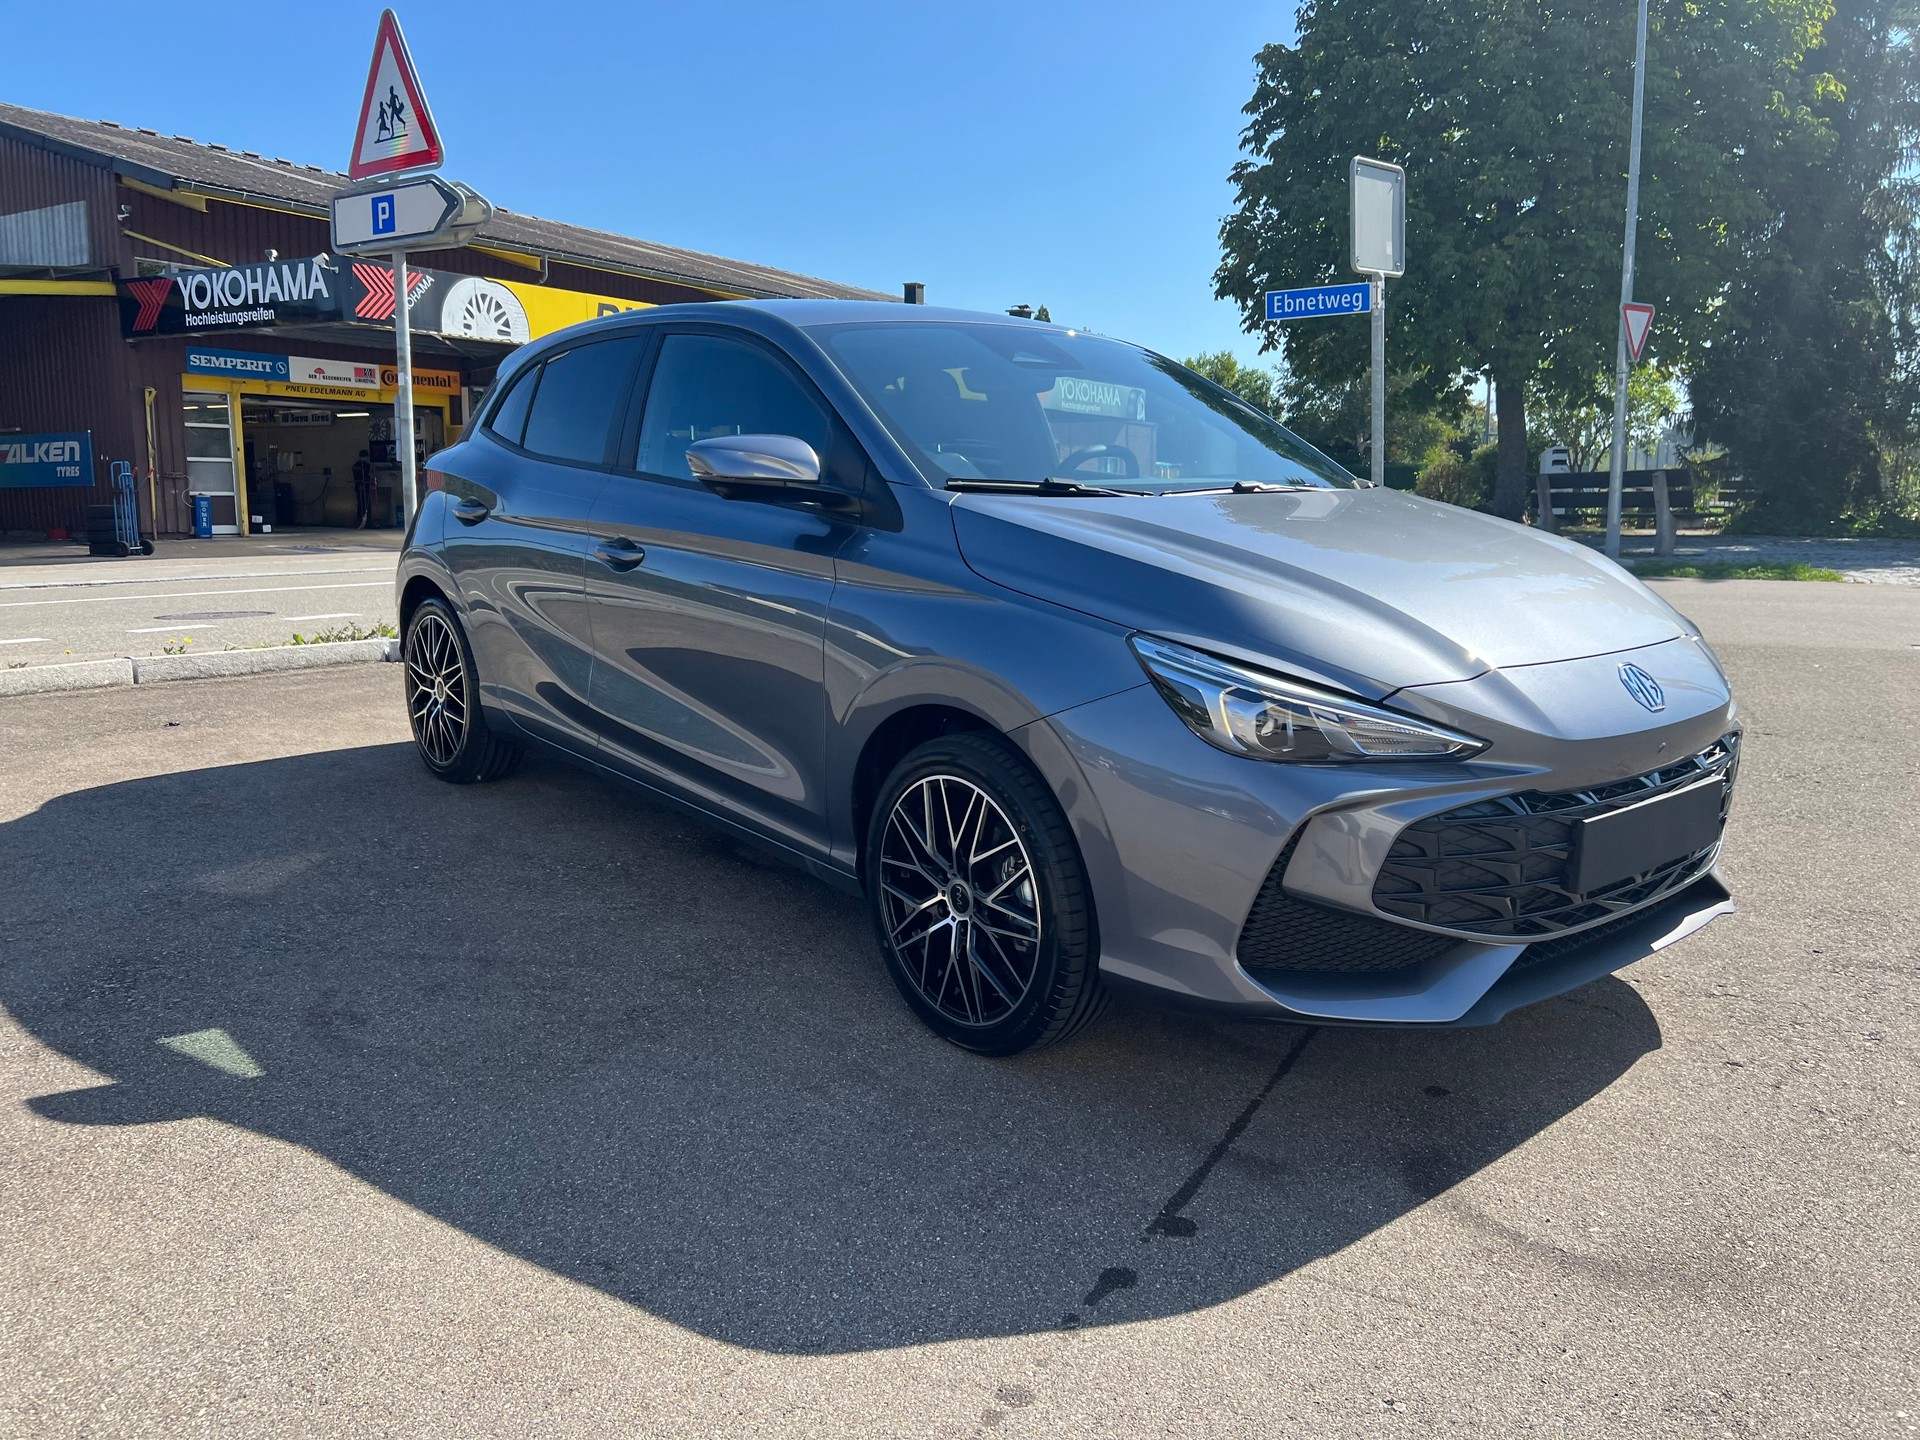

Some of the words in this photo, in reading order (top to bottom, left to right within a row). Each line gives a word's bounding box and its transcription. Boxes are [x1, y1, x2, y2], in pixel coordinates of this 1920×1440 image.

[377, 202, 390, 229] P
[177, 263, 329, 311] YOKOHAMA
[1274, 292, 1362, 312] Ebnetweg
[186, 308, 275, 326] Hochleistungsreifen
[190, 354, 272, 372] SEMPERIT
[381, 369, 451, 388] Conental
[285, 384, 307, 393] PNEU
[309, 386, 353, 396] EDELMANN
[1060, 380, 1121, 406] YOKOHAMA
[290, 413, 309, 423] Sava
[56, 466, 80, 477] TYRES
[1621, 665, 1662, 710] MG
